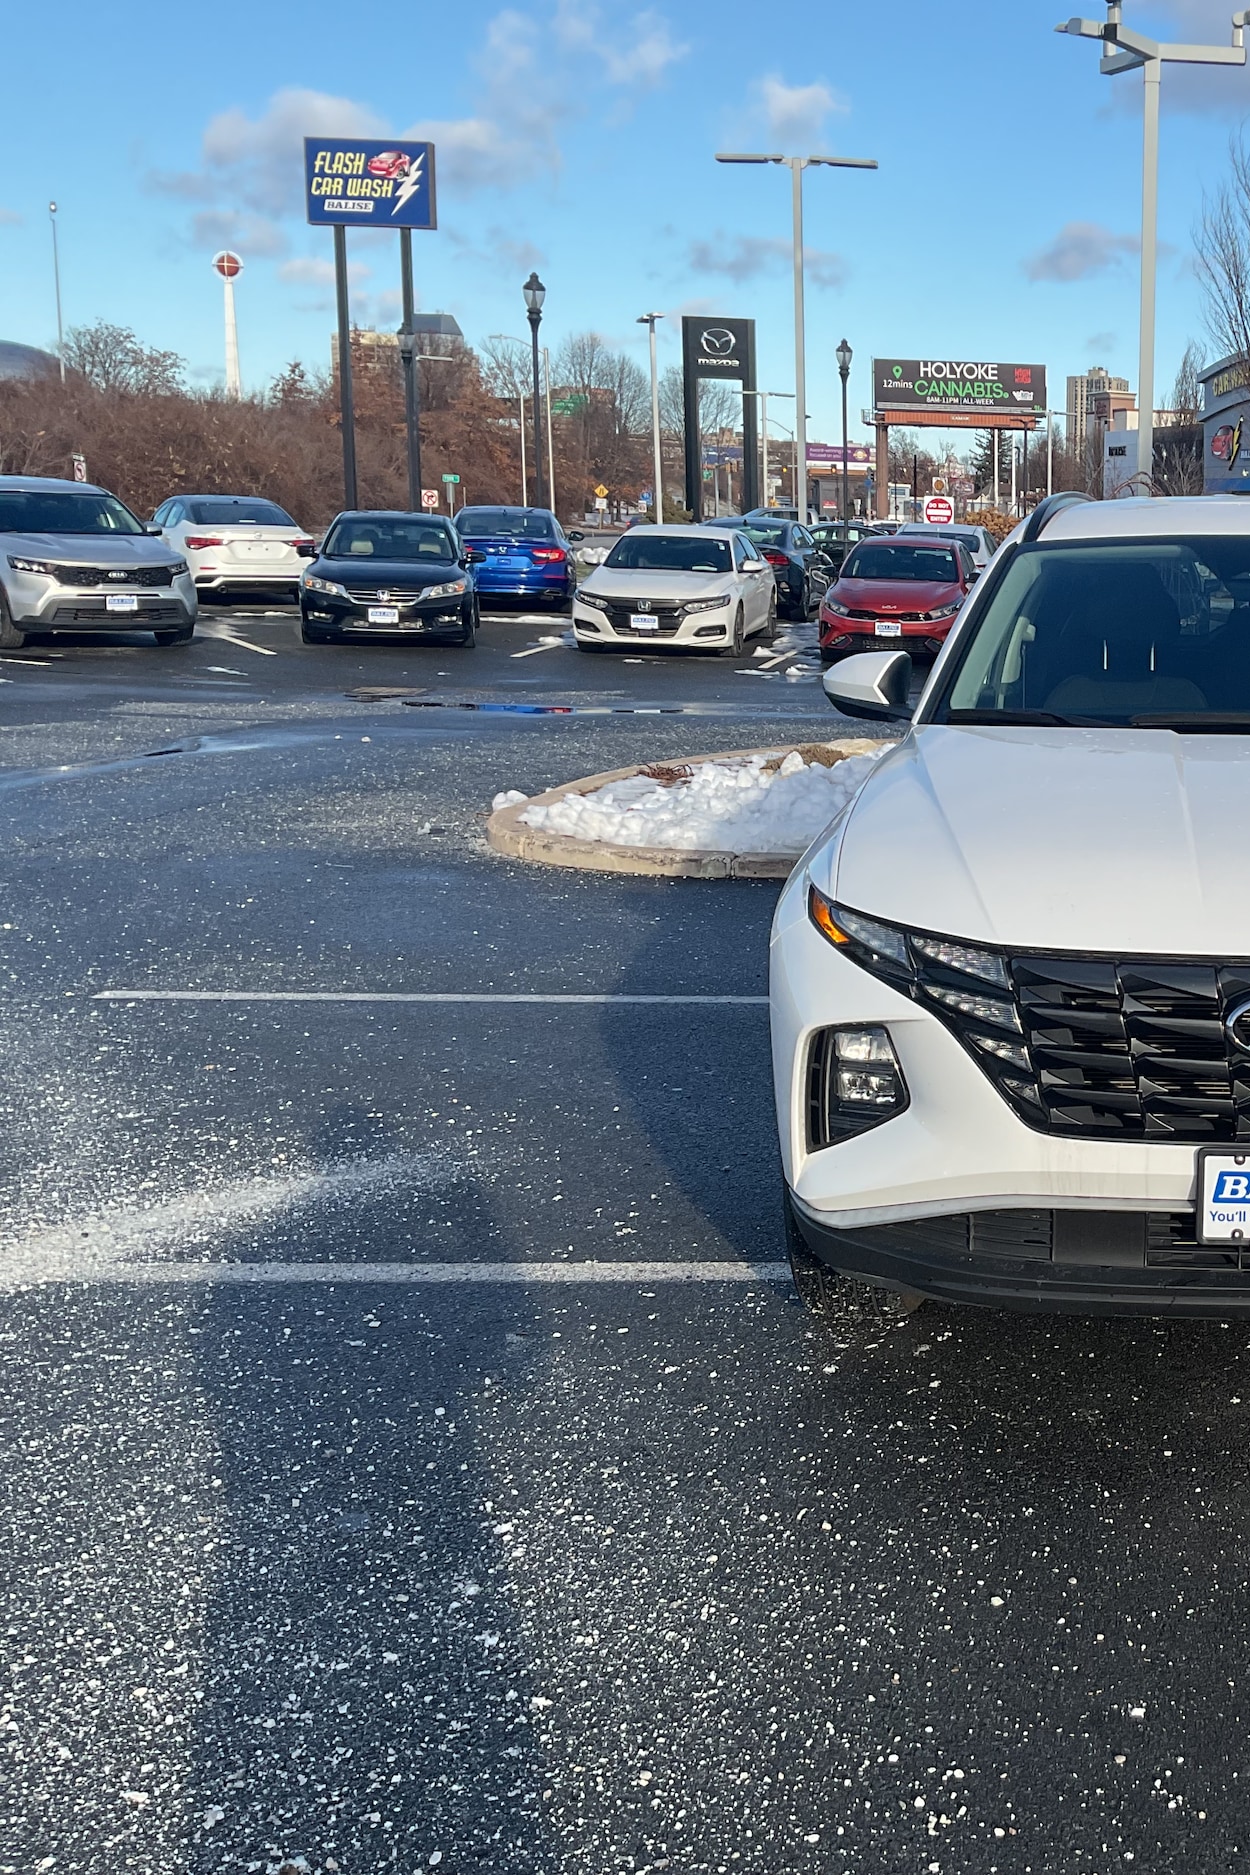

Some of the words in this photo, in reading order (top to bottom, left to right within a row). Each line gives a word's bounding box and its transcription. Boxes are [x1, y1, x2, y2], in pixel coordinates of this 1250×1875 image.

[314, 151, 366, 175] FLASH
[311, 176, 343, 196] CAR
[346, 177, 394, 198] WASH
[326, 200, 372, 211] BALISE
[919, 361, 998, 380] HOLYOKE
[882, 379, 913, 389] 12mins
[1212, 373, 1230, 397] CAR
[1209, 1210, 1246, 1223] You'll
